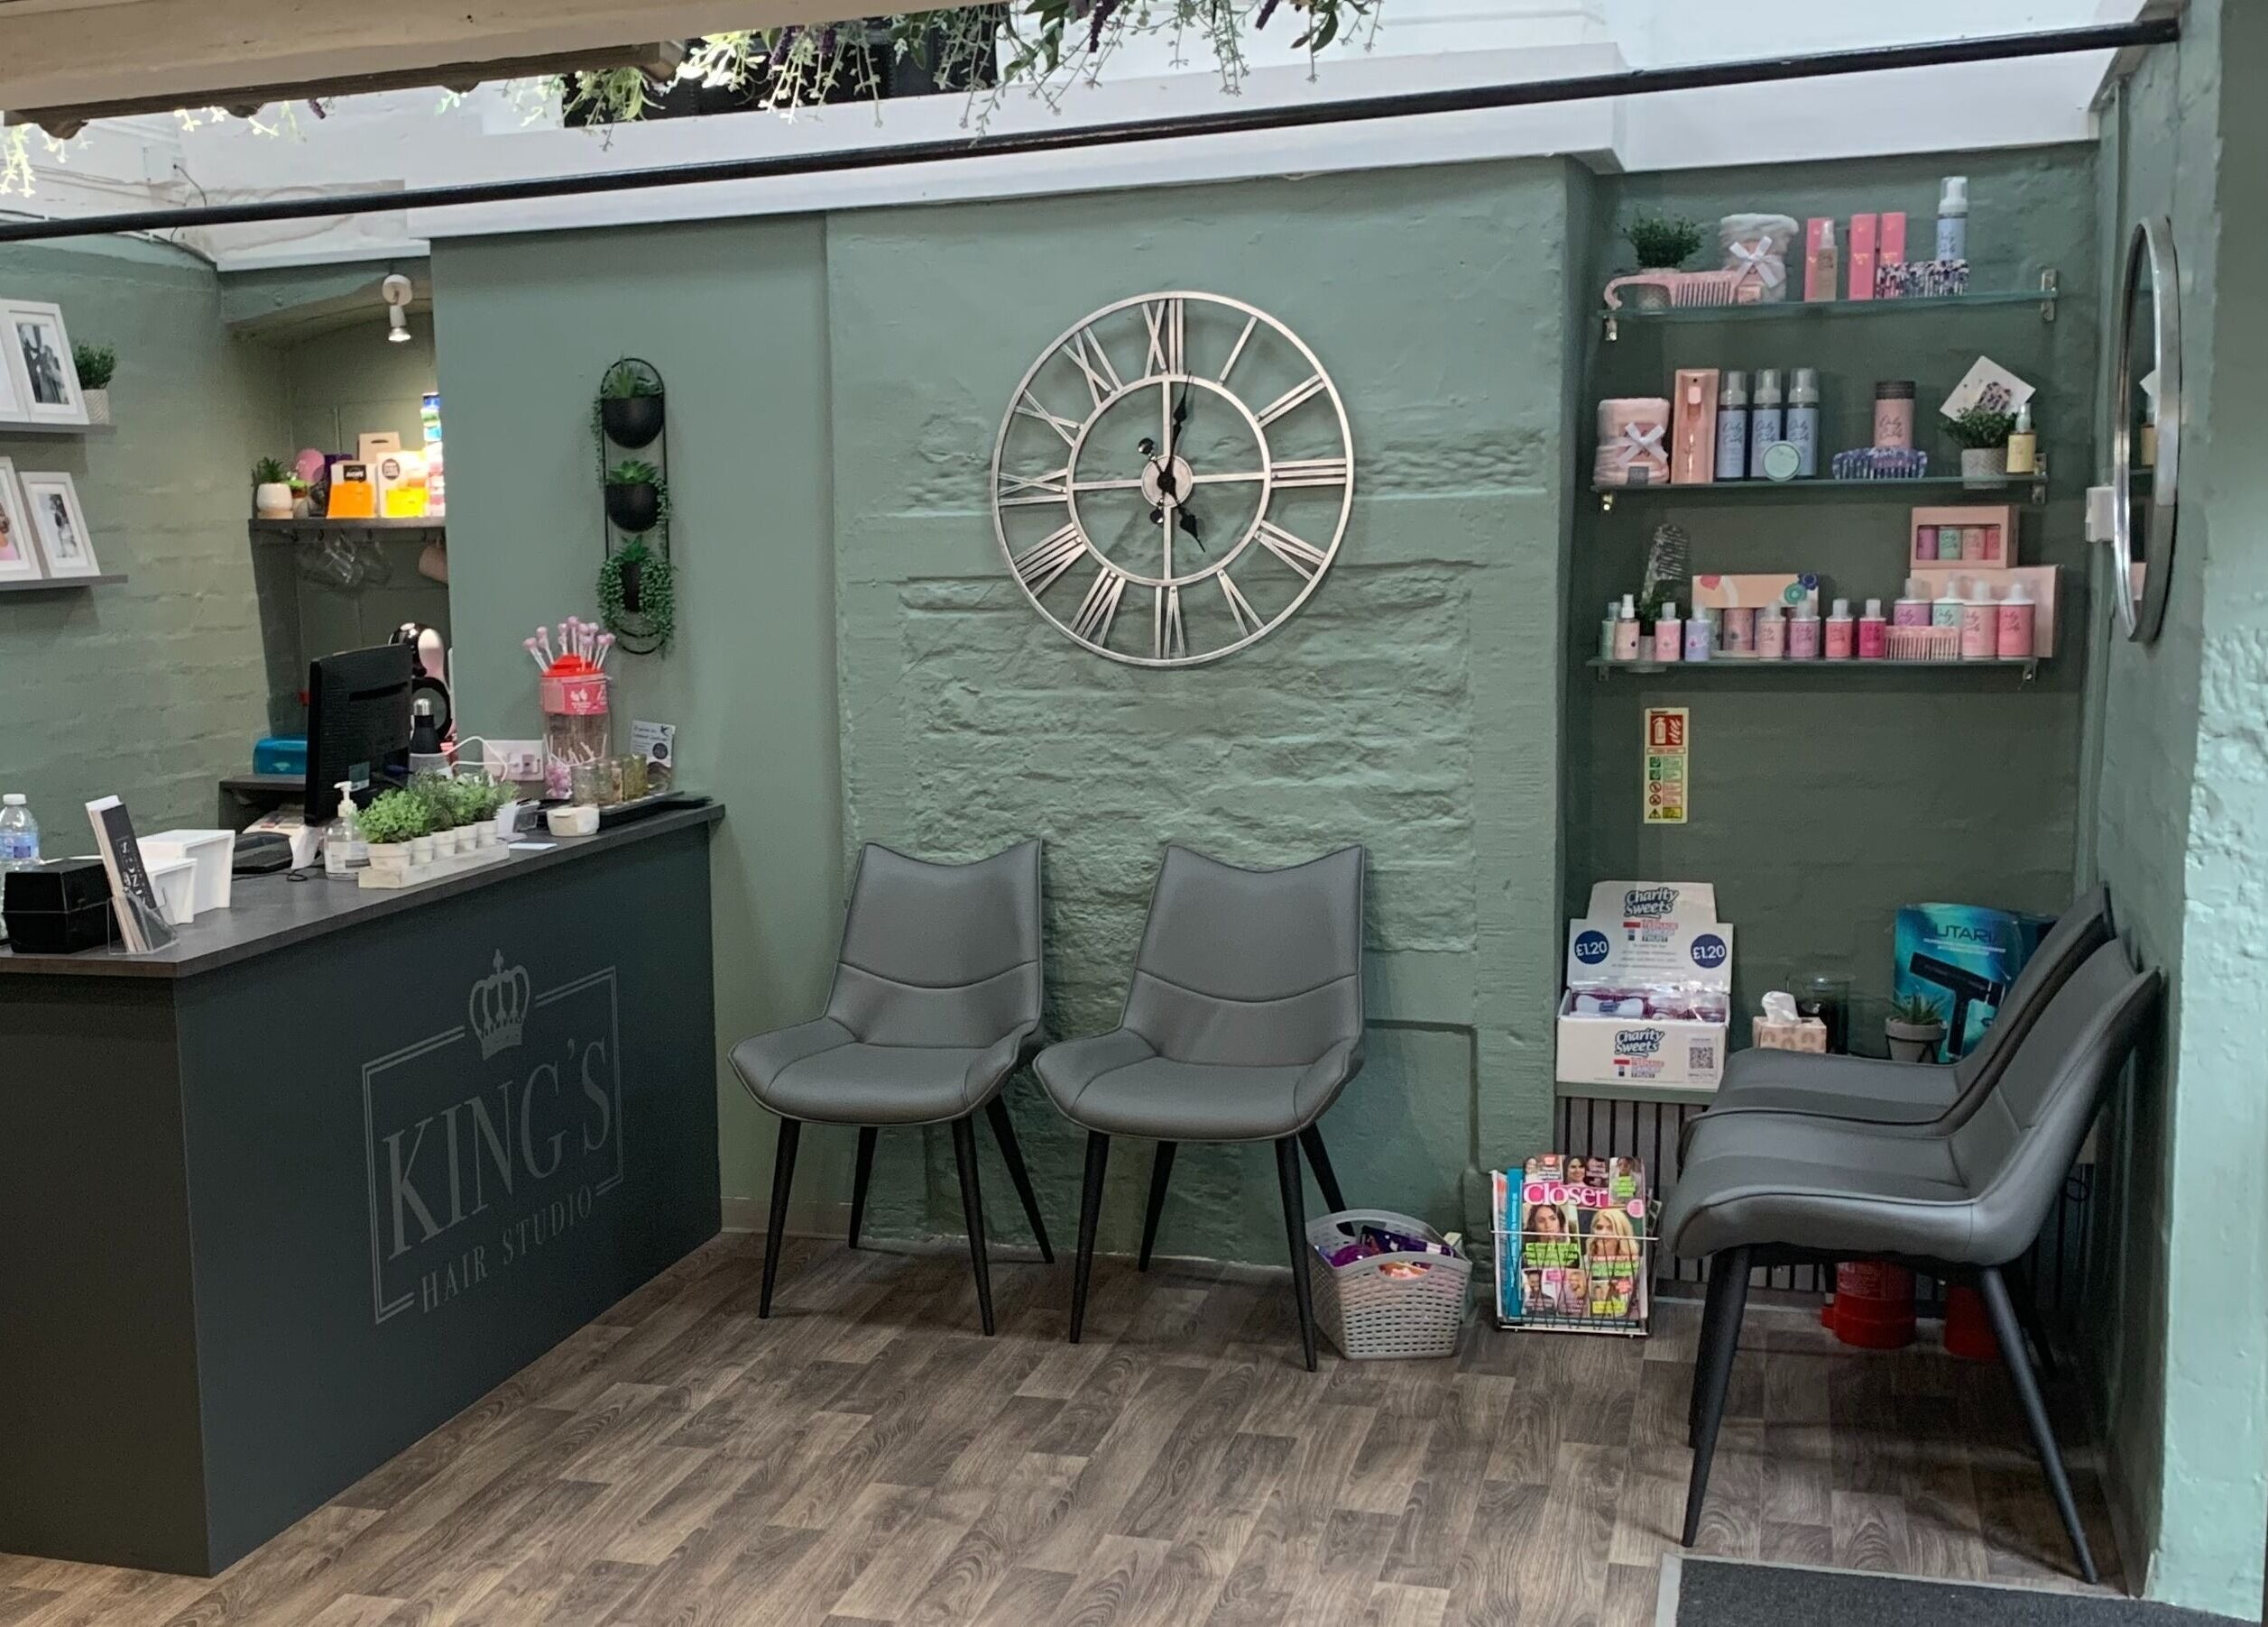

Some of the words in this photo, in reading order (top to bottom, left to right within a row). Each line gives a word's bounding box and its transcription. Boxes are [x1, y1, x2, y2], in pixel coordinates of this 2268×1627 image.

[1626, 887, 1680, 904] Charity
[1625, 901, 1673, 917] Sweets
[1576, 941, 1608, 957] £1.20
[1692, 944, 1726, 960] £1.20
[1615, 1028, 1665, 1044] Charity
[1615, 1041, 1660, 1055] Sweets
[383, 1037, 611, 1261] KING'S
[1523, 1182, 1609, 1209] Closer
[421, 1246, 489, 1313] HAIR
[502, 1184, 593, 1265] STUDIO
